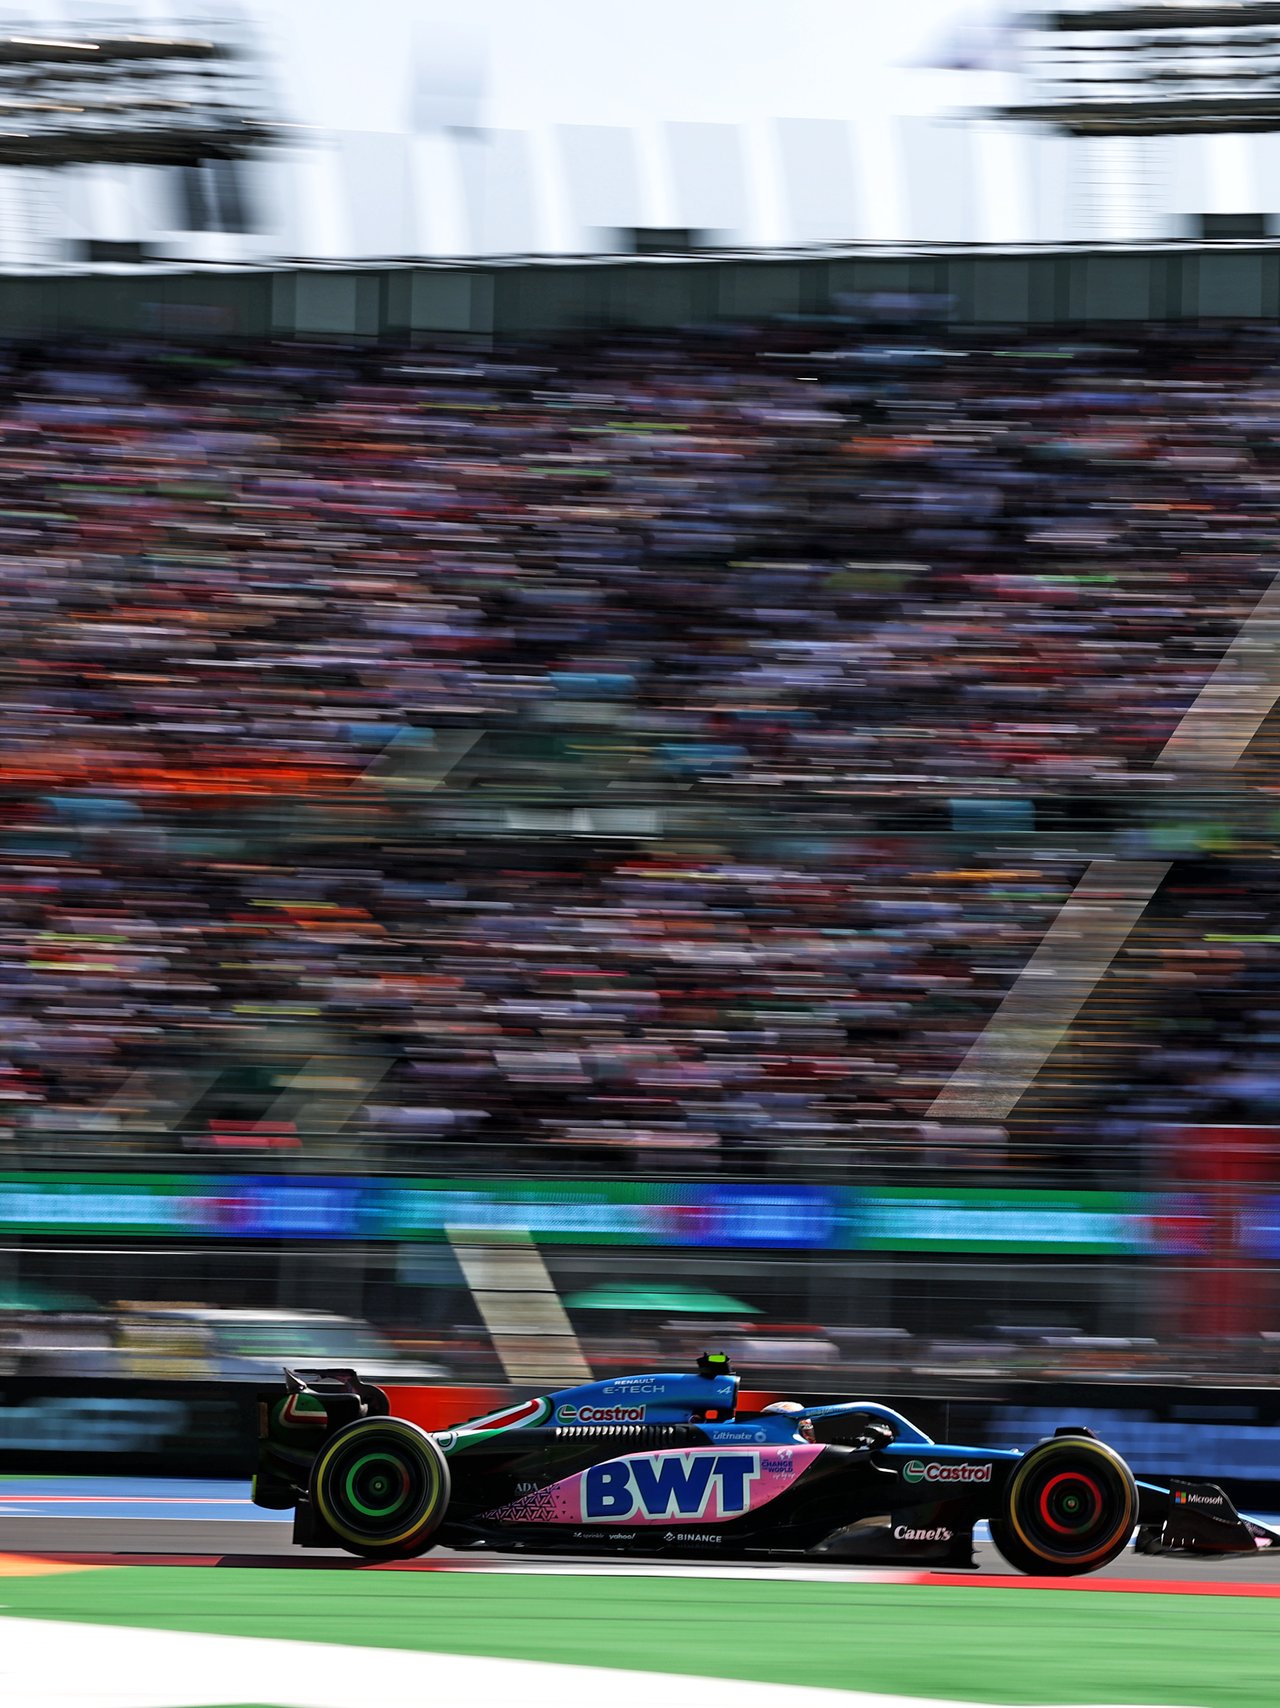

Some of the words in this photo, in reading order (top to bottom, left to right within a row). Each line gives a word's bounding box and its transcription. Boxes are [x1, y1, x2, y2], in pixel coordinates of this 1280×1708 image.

[614, 1378, 655, 1386] RENAULT
[603, 1385, 665, 1394] E-TECH
[579, 1404, 646, 1422] Castrol
[925, 1463, 992, 1482] Castrol
[584, 1454, 757, 1520] BWT
[1187, 1494, 1223, 1505] Microsoft
[609, 1532, 636, 1540] yahoo!
[677, 1533, 722, 1543] BINANCE
[894, 1525, 953, 1540] Canel's
